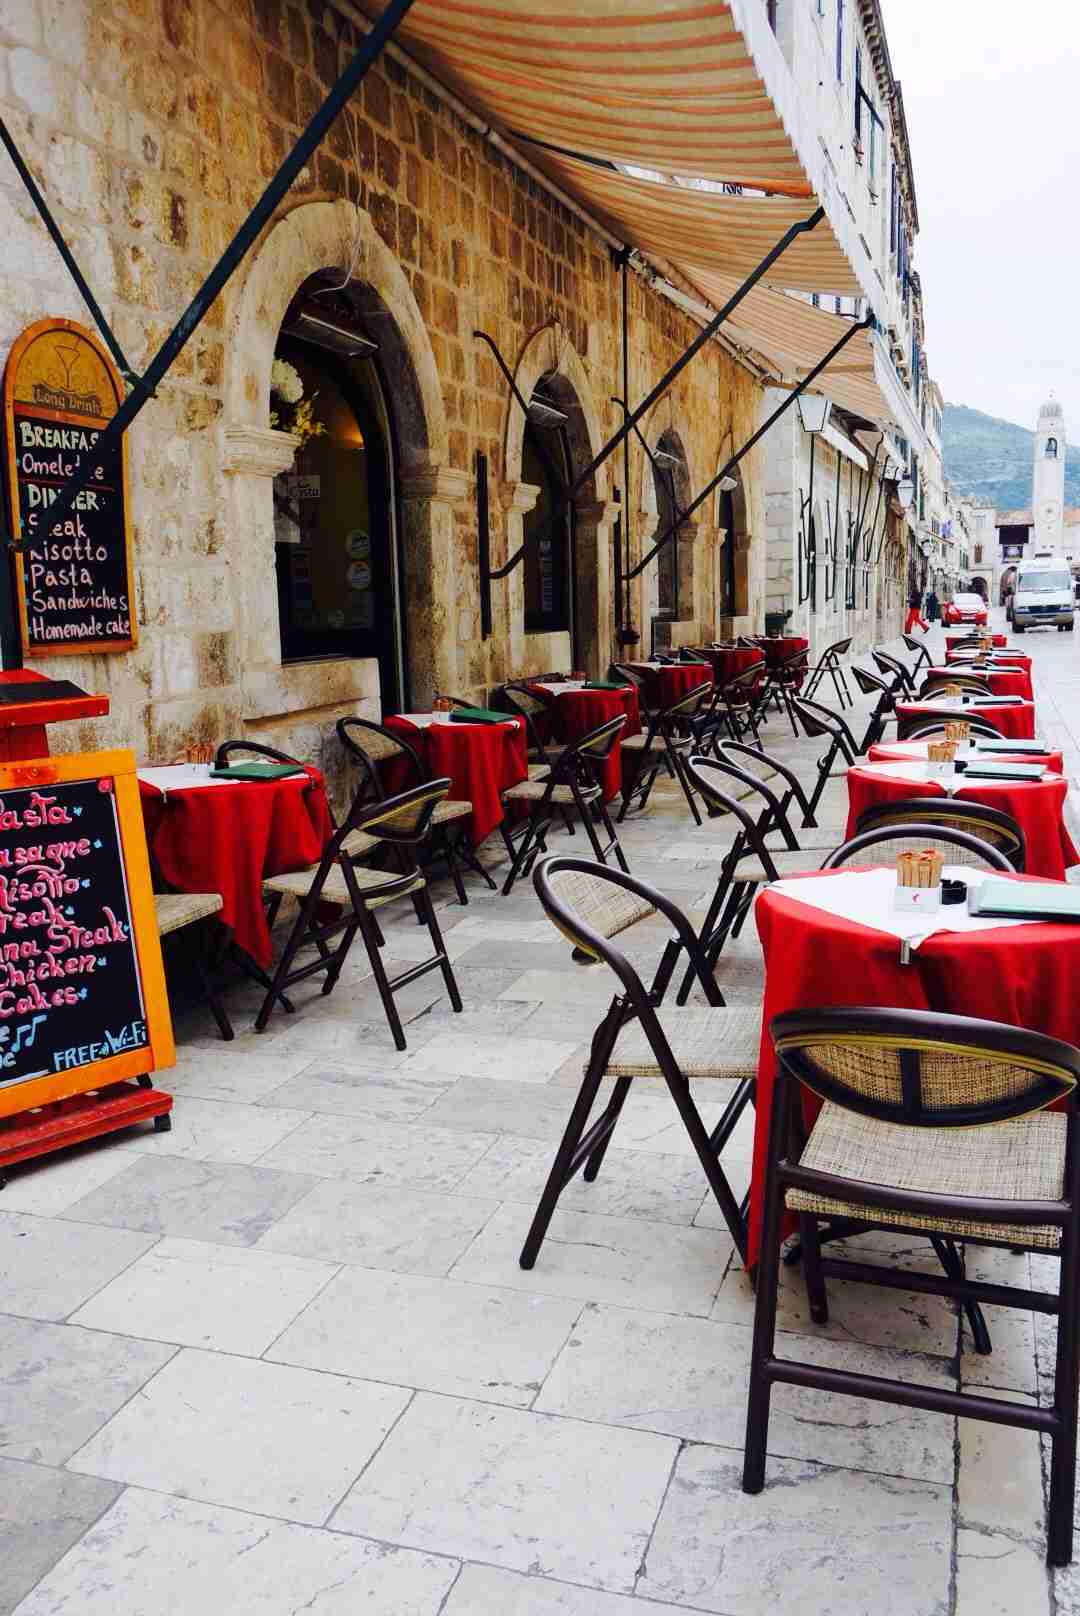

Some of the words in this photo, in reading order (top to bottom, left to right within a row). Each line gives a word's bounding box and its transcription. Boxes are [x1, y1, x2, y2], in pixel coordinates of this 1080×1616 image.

[19, 421, 99, 452] BREAKFAS
[22, 453, 104, 481] Omelee
[28, 513, 87, 538] Seak
[31, 564, 93, 589] Pasta
[32, 588, 128, 612] Sandwiches
[32, 615, 104, 640] Homemade
[0, 839, 91, 874] asagne
[0, 983, 80, 1018] Cakes
[53, 1042, 101, 1072] FREE
